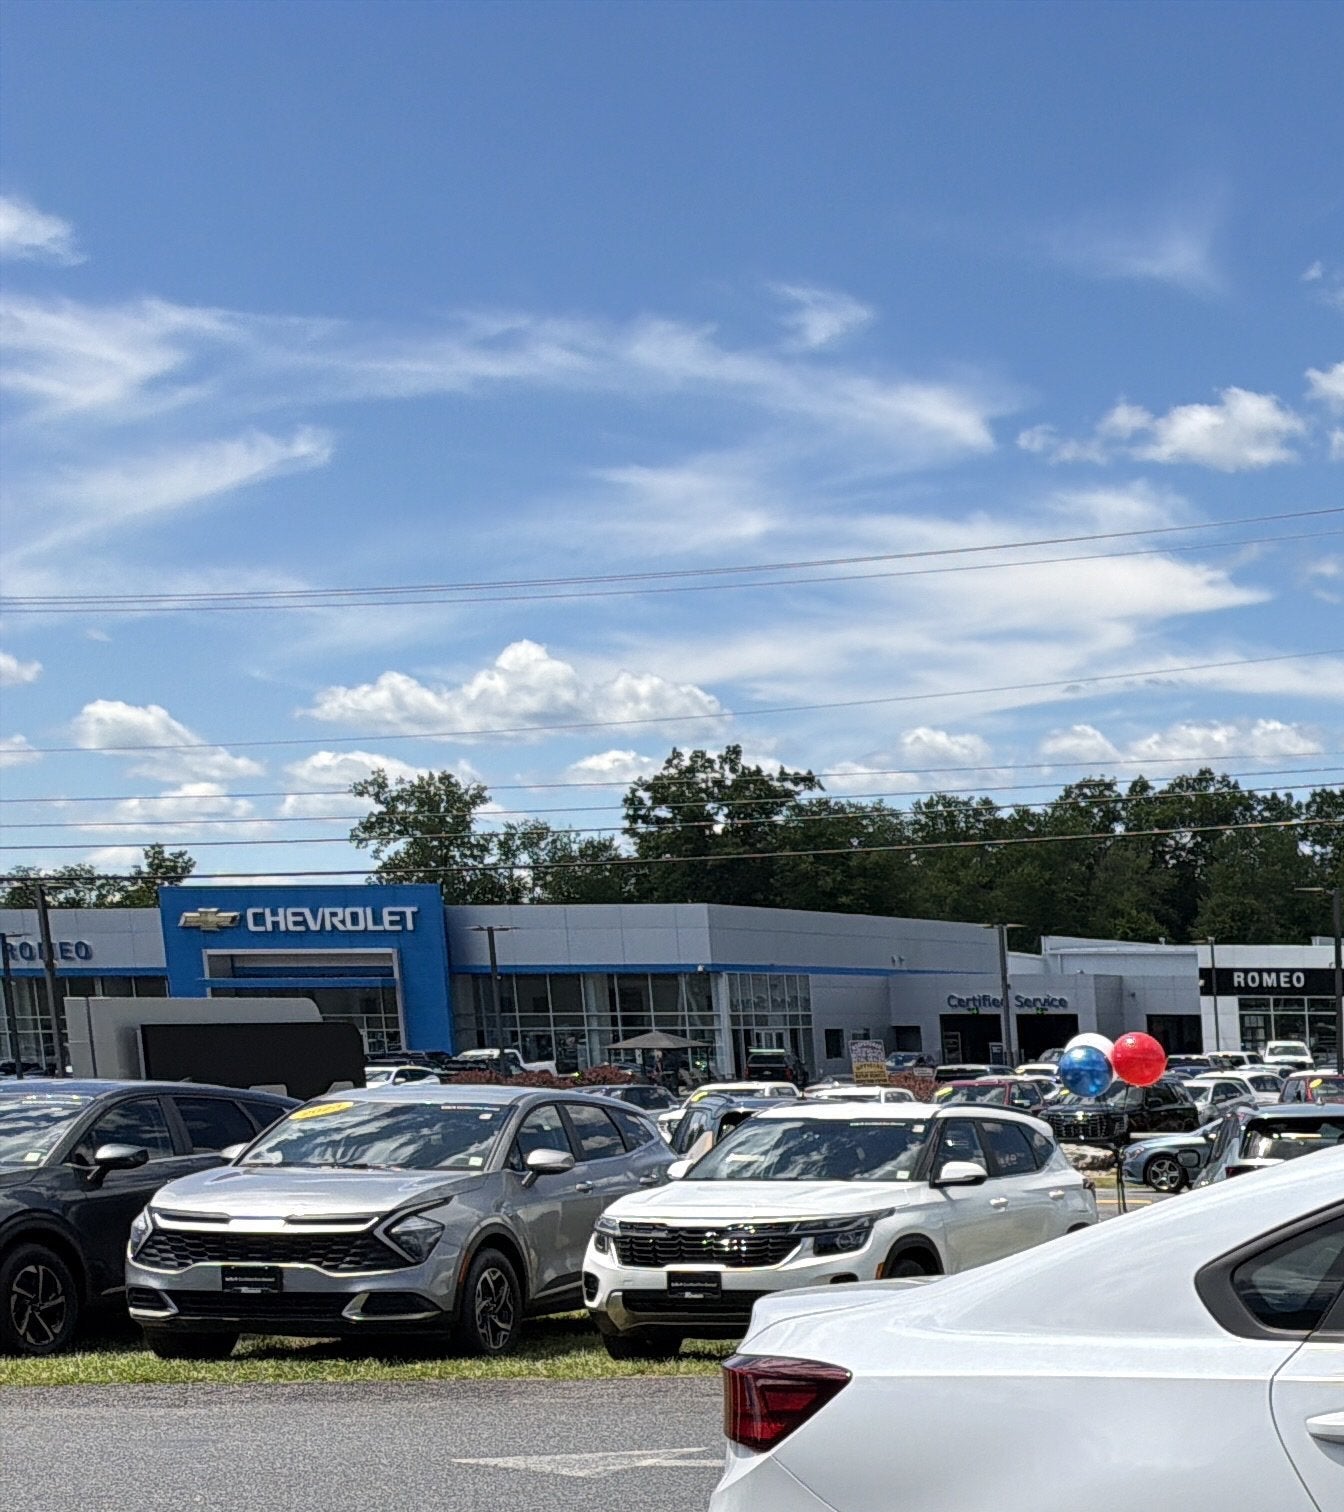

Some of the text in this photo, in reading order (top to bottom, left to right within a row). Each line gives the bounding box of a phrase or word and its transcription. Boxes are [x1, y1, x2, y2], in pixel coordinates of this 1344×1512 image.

[246, 905, 418, 932] CHEVROLET
[1233, 972, 1305, 988] ROMEO
[947, 994, 1068, 1008] Certifie Service
